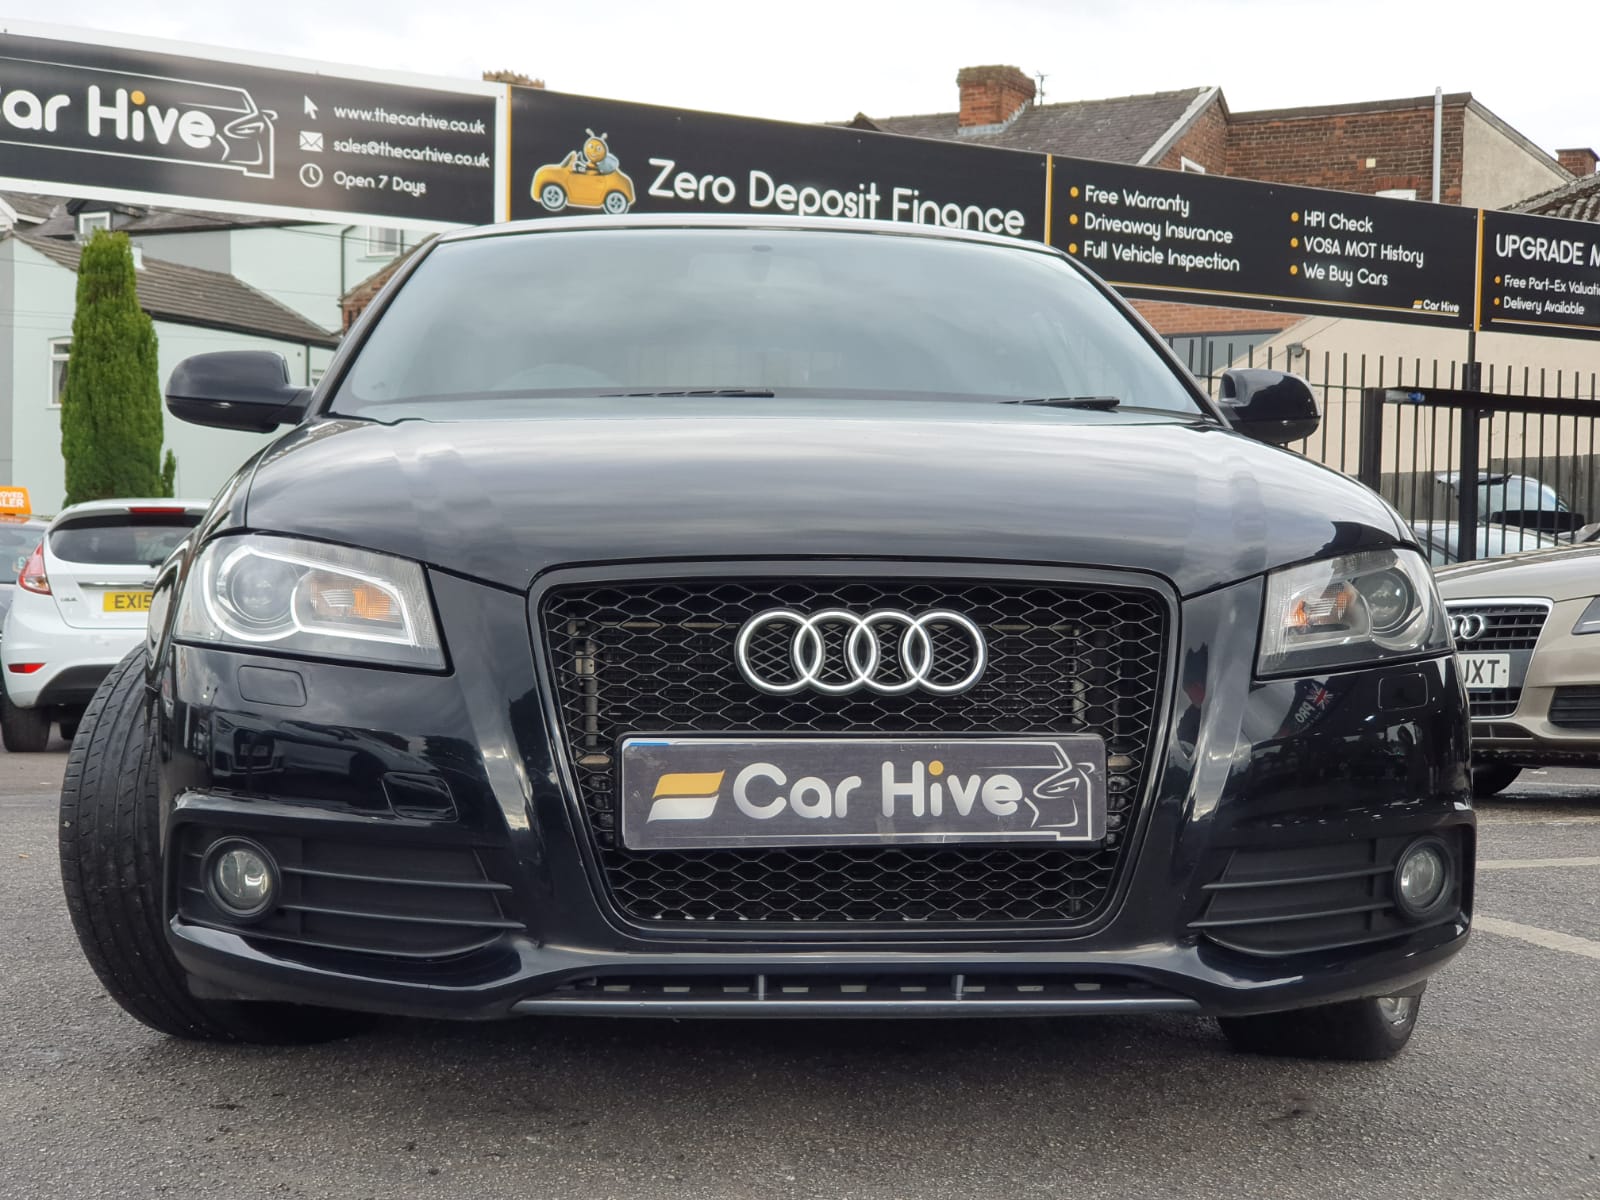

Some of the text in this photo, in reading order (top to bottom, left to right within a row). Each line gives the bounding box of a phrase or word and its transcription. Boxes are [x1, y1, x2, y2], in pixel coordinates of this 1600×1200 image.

[0, 84, 215, 149] ar Hive
[334, 106, 485, 134] www.thecarhive.co.uk
[333, 138, 490, 168] sales@thecarhive.co.uk
[333, 170, 426, 197] Open 7 Days
[648, 158, 1025, 236] Zero Deposit Finance
[1085, 185, 1190, 218] Free Warranty
[1084, 212, 1234, 244] Driveaway Insurance
[1303, 210, 1373, 233] HPI Check
[1083, 240, 1240, 272] Full Vehicle Inspection
[1303, 236, 1424, 269] VOSA MOT History
[1496, 233, 1585, 265] UPGRADE
[1303, 262, 1389, 287] We Buy Cars
[1504, 274, 1600, 297] Free Part-Ex Valuati
[1423, 300, 1460, 313] Car Hive
[1503, 296, 1585, 315] Delivery Available
[733, 760, 1023, 820] Car Hive
